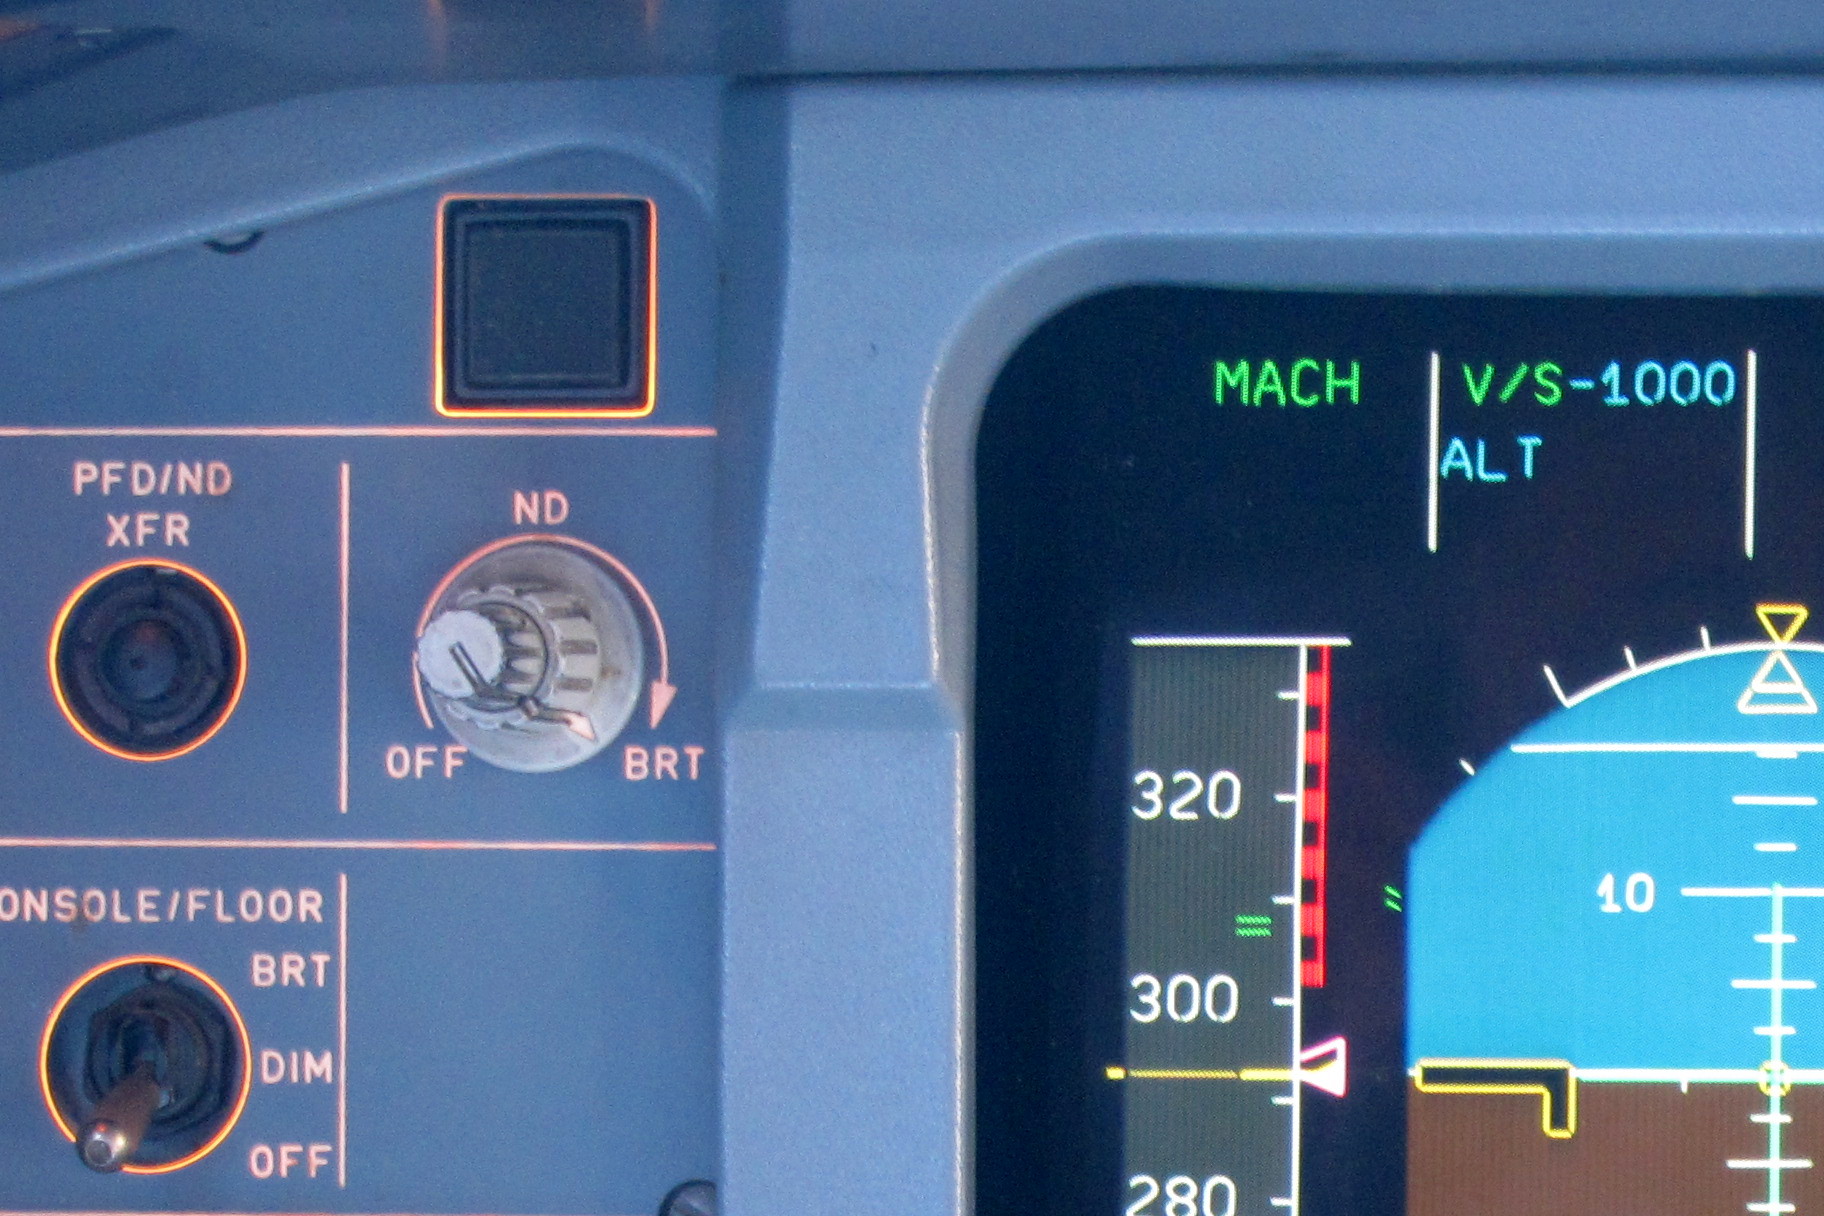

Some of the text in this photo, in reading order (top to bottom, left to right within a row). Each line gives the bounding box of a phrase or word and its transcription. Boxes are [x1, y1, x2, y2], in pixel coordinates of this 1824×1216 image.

[1215, 359, 1360, 406] MACH
[1441, 436, 1543, 482] ALT
[73, 461, 233, 496] PFD/ND
[513, 490, 570, 524] ND
[106, 513, 190, 547] XFR
[386, 744, 468, 779] OFF
[624, 745, 705, 780] BRT
[1131, 770, 1242, 820] 320
[1597, 872, 1656, 914] 10
[252, 953, 331, 989] BRT
[1129, 973, 1239, 1024] 300
[260, 1049, 333, 1084] DIM
[249, 1144, 332, 1179] OFF
